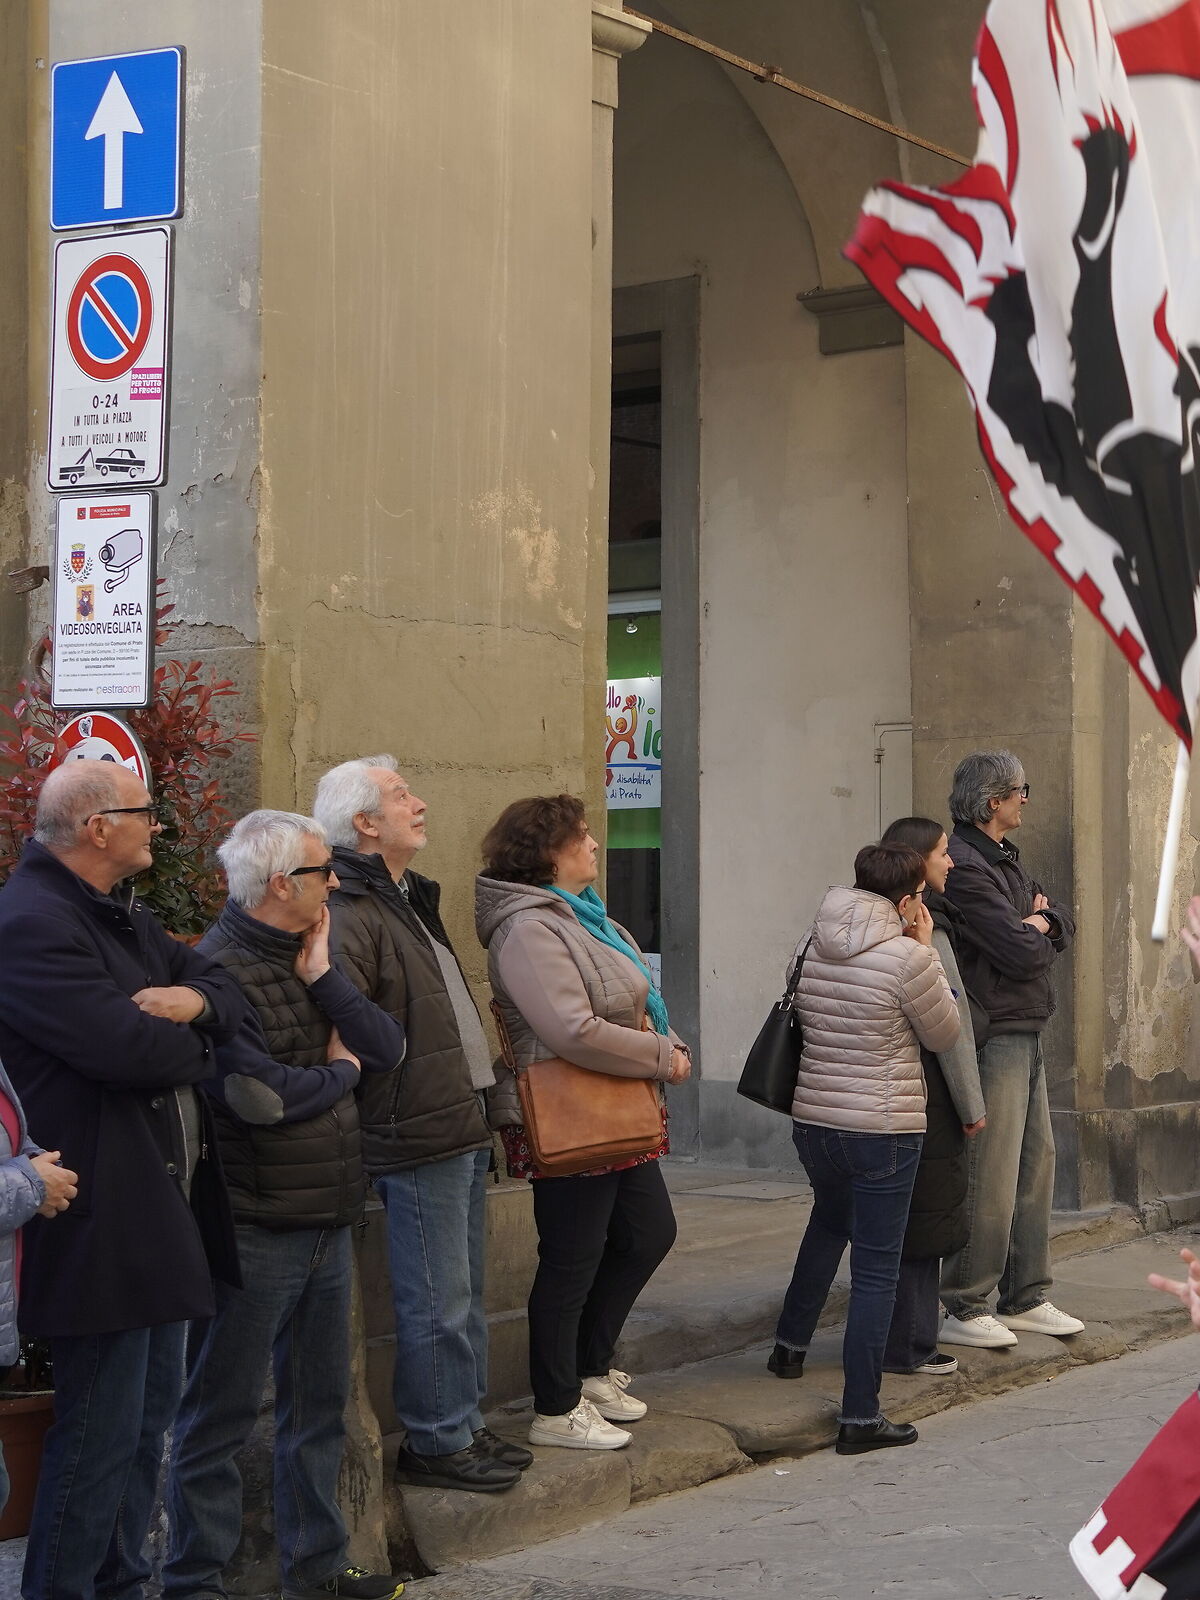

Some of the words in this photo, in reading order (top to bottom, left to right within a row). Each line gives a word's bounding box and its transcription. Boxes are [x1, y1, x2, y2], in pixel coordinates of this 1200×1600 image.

[92, 393, 119, 409] 0-24
[73, 415, 81, 427] IN
[84, 413, 99, 426] TUTTA
[102, 413, 109, 425] LA
[113, 411, 132, 424] PIAZZA
[61, 436, 66, 447] A
[69, 434, 83, 446] TUTTI
[92, 432, 114, 445] VEICOLI
[117, 432, 122, 443] A
[125, 430, 147, 443] MOTORE
[112, 602, 143, 617] AREA
[60, 621, 143, 636] VIDEOSORVEGLIATA
[102, 684, 141, 694] estracom
[610, 789, 617, 799] di
[619, 787, 642, 799] Prato
